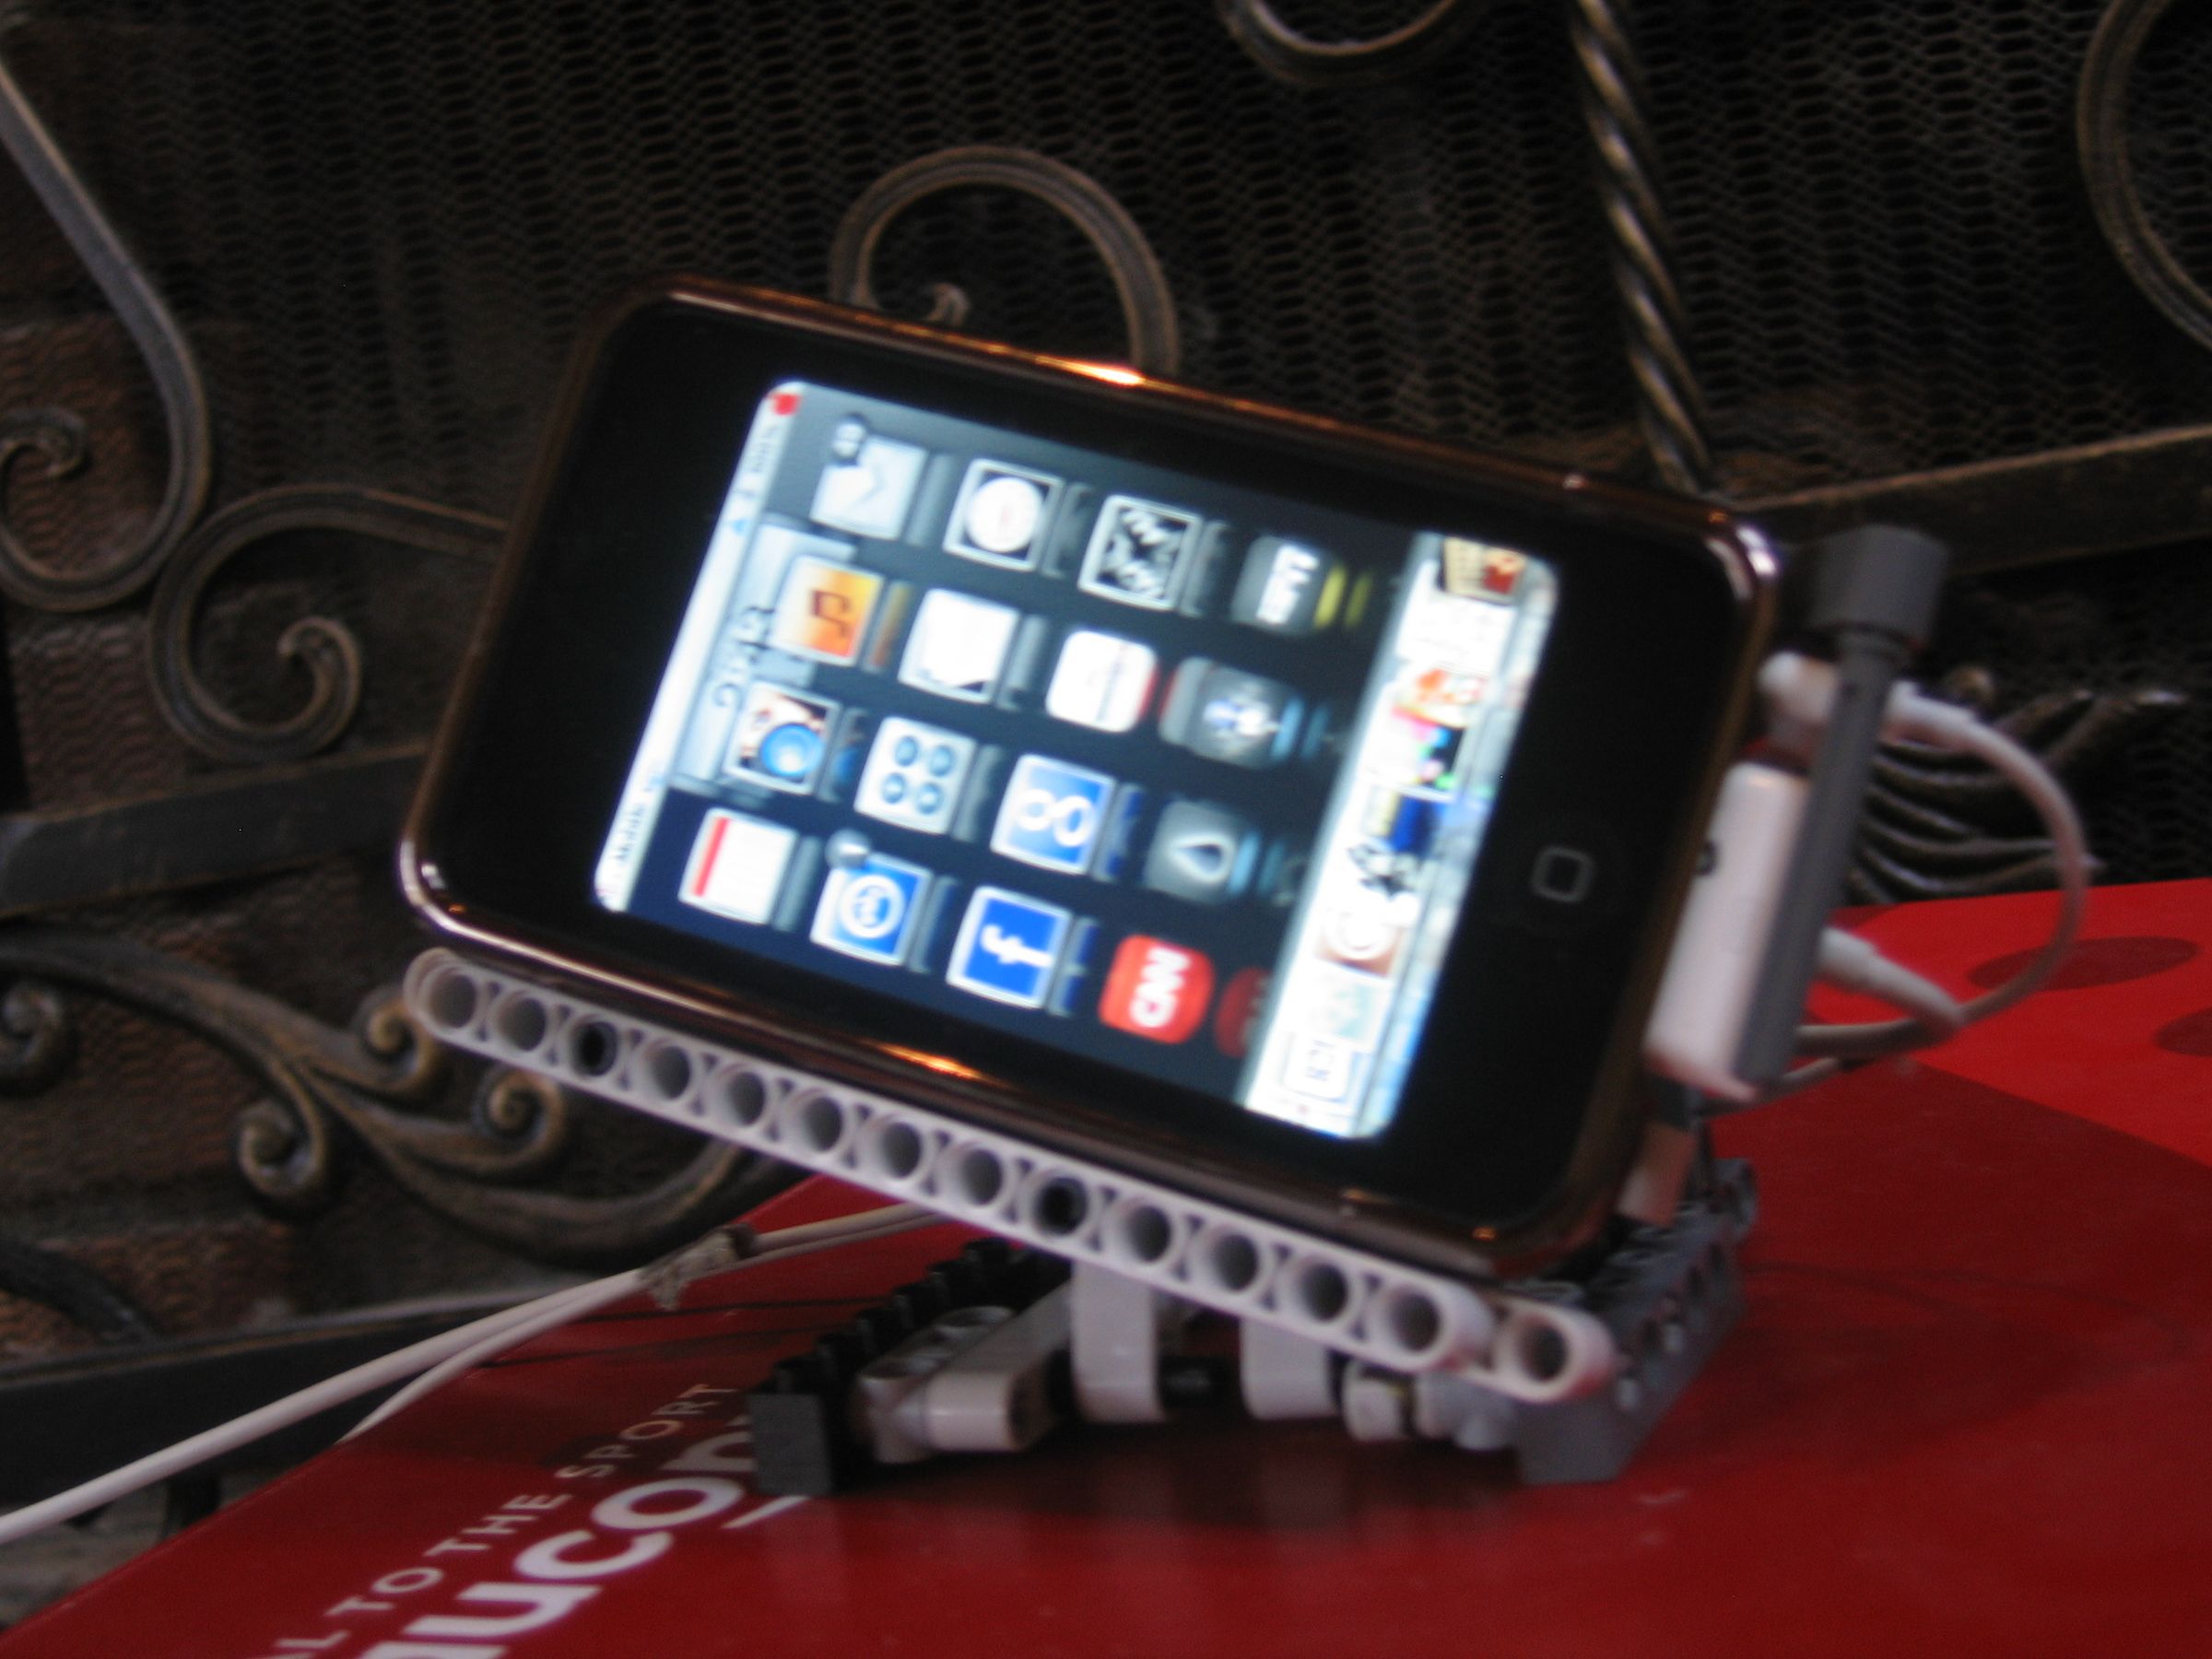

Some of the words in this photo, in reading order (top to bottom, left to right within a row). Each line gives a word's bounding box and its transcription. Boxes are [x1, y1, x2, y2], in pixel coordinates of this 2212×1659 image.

[1129, 945, 1192, 1029] CNN
[324, 1567, 446, 1617] TO
[422, 1493, 575, 1558] THE
[554, 1383, 738, 1478] SPORT
